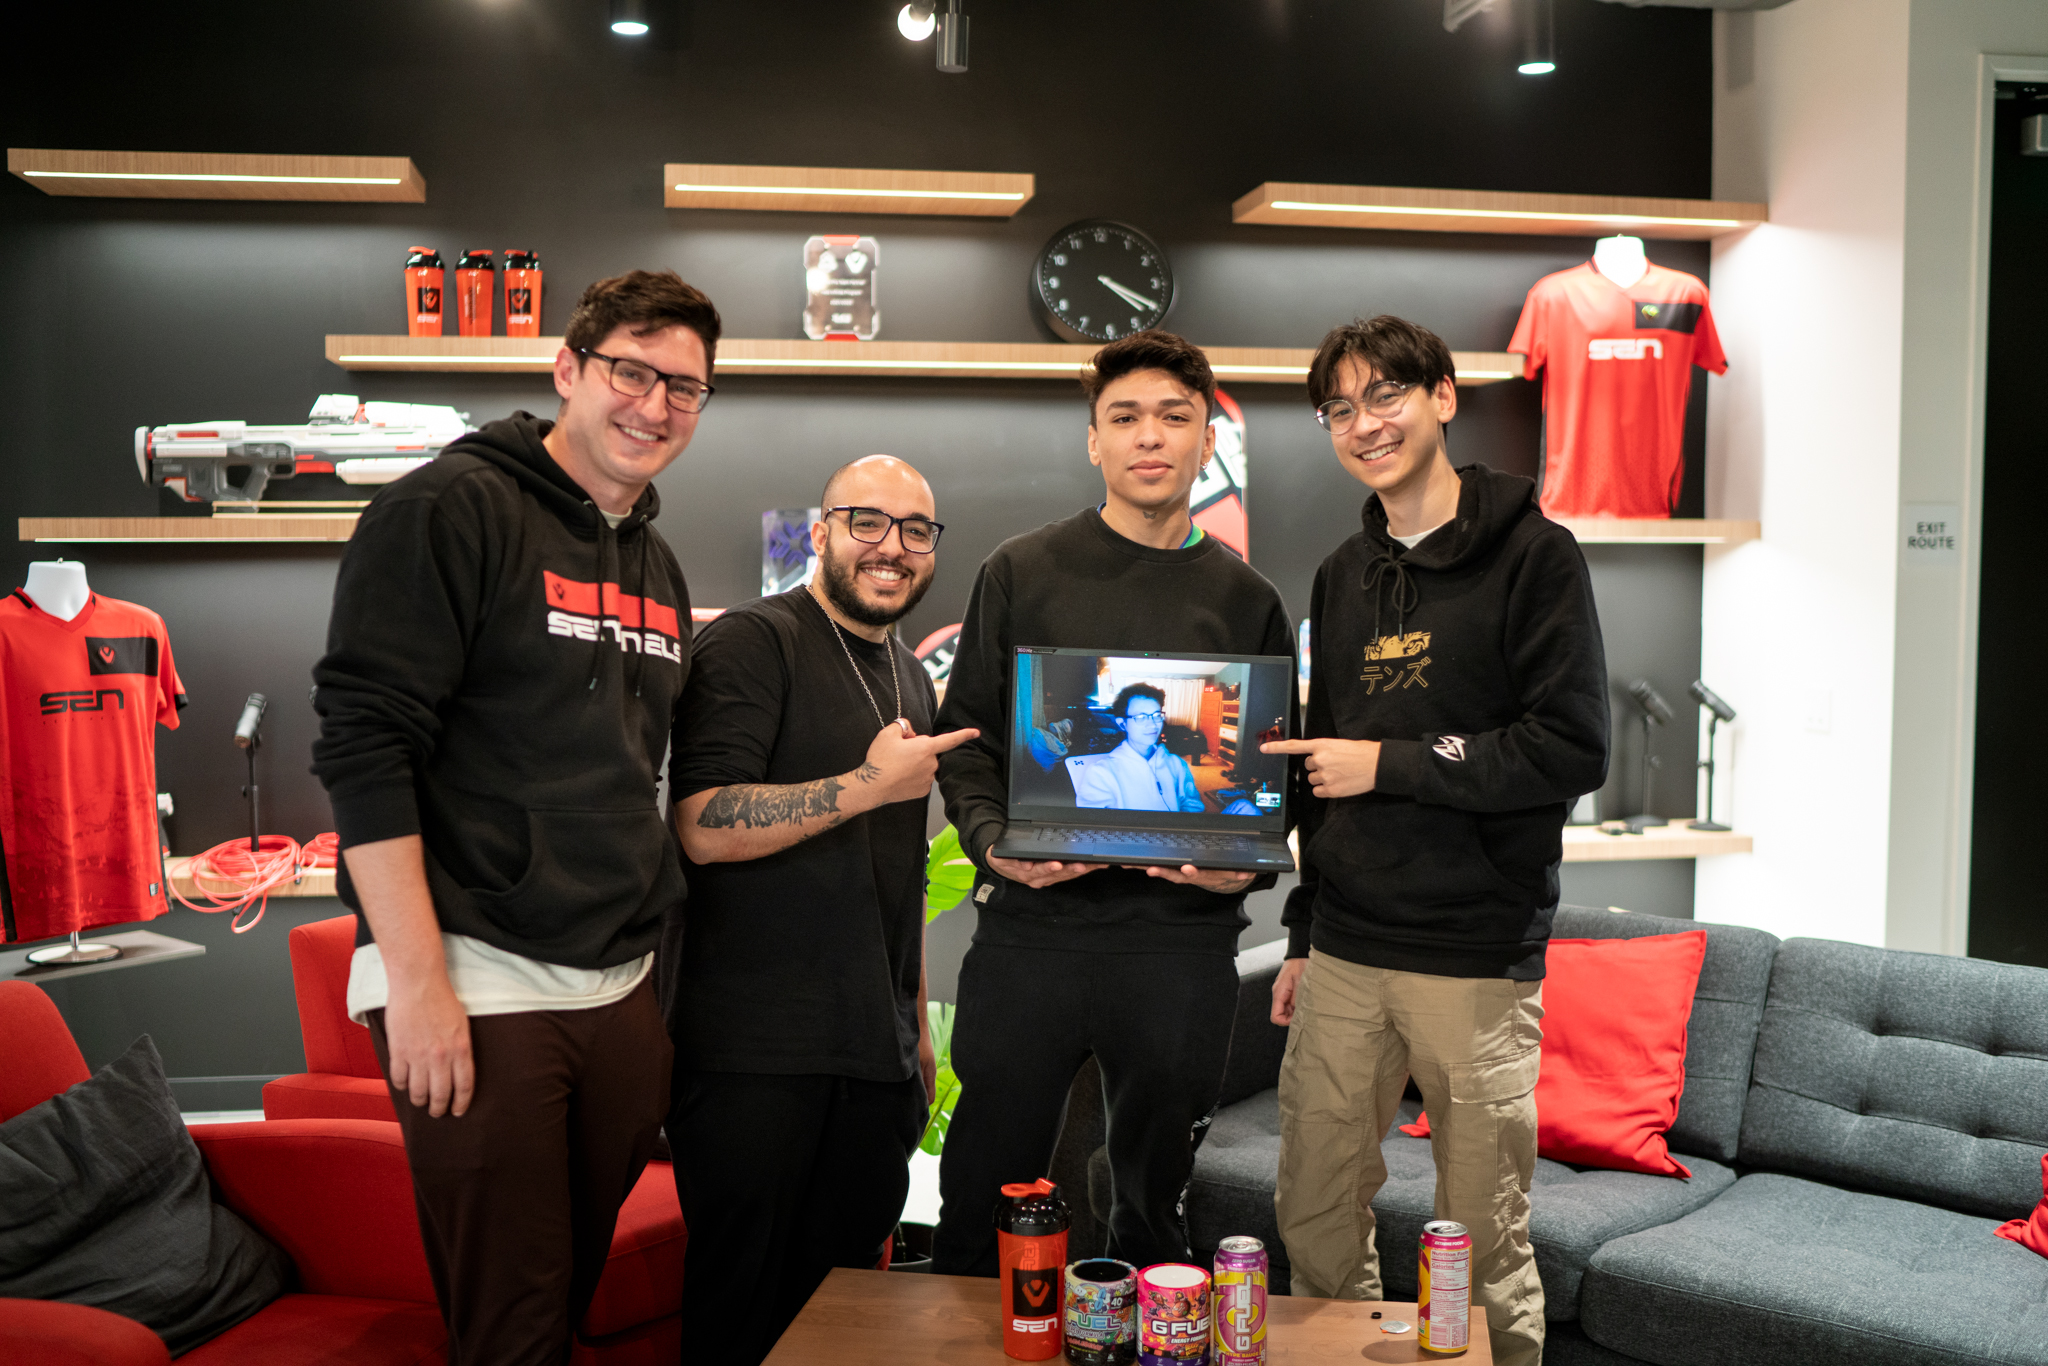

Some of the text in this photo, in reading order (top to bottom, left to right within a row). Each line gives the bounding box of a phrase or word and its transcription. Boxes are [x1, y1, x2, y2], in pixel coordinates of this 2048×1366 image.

[1094, 232, 1106, 243] 12
[1070, 239, 1081, 249] 11
[1124, 240, 1131, 250] 1
[1053, 254, 1066, 266] 10
[1141, 255, 1150, 266] 2
[1049, 277, 1059, 289] 9
[1151, 277, 1160, 289] 3
[1059, 299, 1069, 311] 8
[1080, 317, 1089, 328] 7
[1130, 317, 1140, 329] 5
[1105, 324, 1115, 336] 6
[1917, 521, 1946, 534] EXIT
[1907, 536, 1955, 550] ROUTE
[1360, 656, 1432, 695] テンズ
[1111, 1297, 1123, 1307] 40
[1236, 1275, 1251, 1333] FUEL
[1152, 1315, 1211, 1336] G FUE
[1236, 1336, 1250, 1351] G
